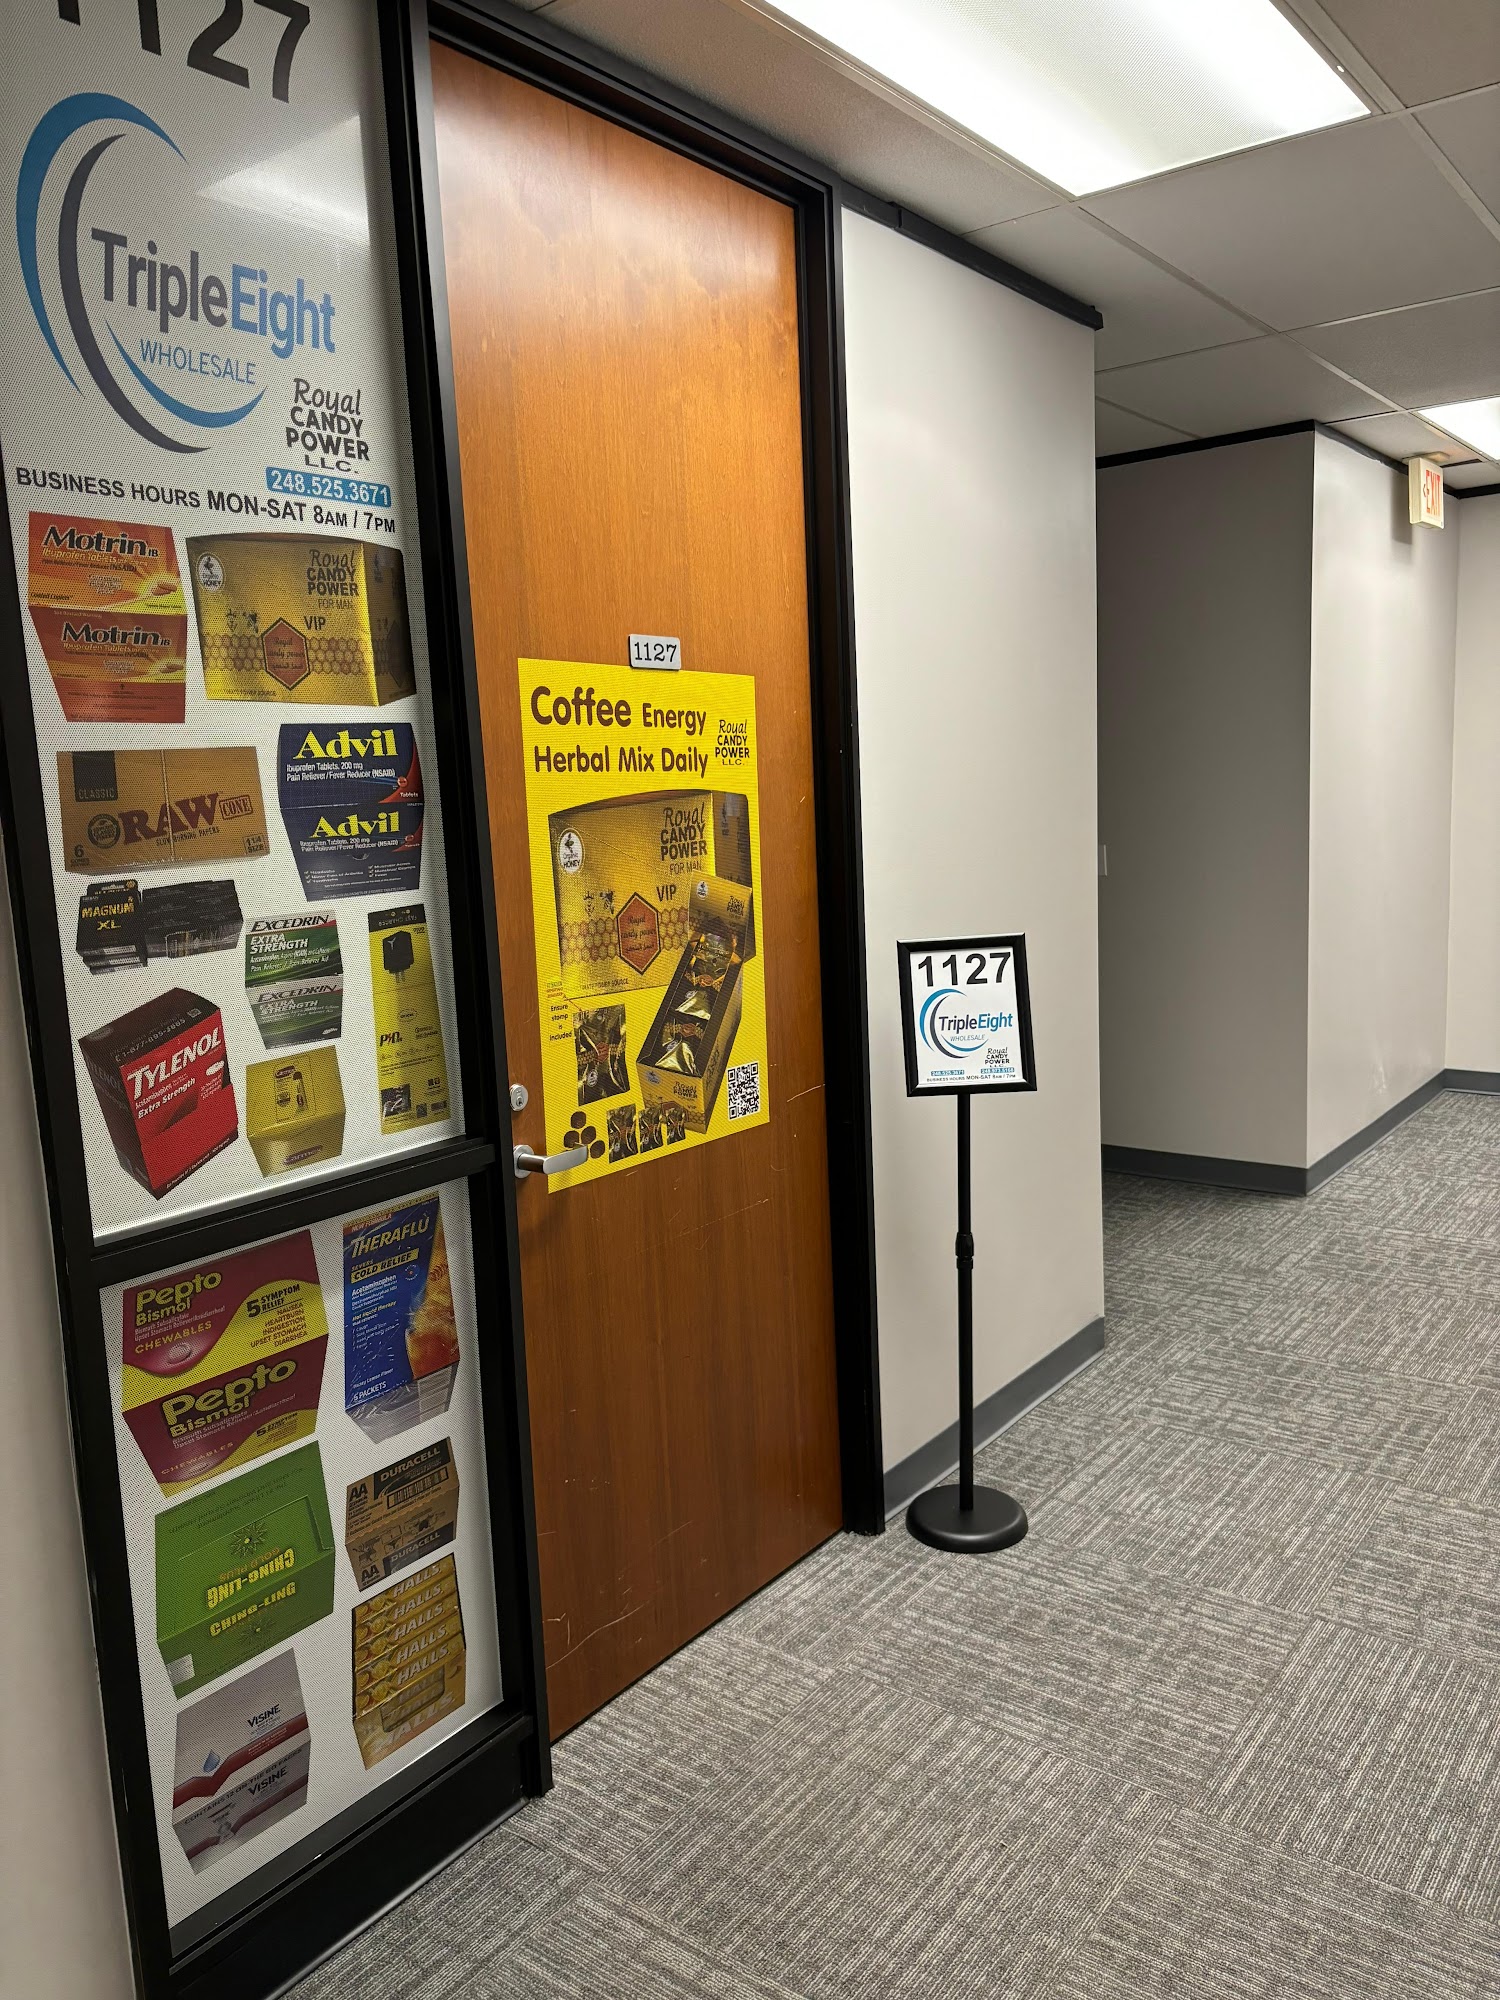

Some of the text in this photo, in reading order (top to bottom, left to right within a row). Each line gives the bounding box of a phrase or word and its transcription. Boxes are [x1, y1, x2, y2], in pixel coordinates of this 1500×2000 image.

[57, 0, 310, 104] 27
[91, 227, 336, 360] TripleEight
[140, 338, 257, 385] WHOLESALE
[293, 377, 361, 417] Royal
[290, 406, 363, 438] CANDY
[285, 426, 370, 461] POWER
[304, 454, 360, 475] LLC.
[270, 470, 389, 507] 248.525.3671
[1425, 469, 1441, 517] EXIT
[15, 467, 126, 498] BUSINESS
[131, 482, 201, 509] HOURS
[207, 489, 308, 523] MON-SAT
[363, 512, 396, 534] 7PM
[42, 525, 149, 556] Motrin
[308, 549, 356, 572] Royal
[306, 566, 357, 583] CANDY
[306, 581, 360, 598] POWER
[318, 598, 335, 610] FOR
[62, 621, 161, 647] Motrin
[303, 615, 327, 632] VIP
[633, 642, 678, 663] 1127
[530, 685, 707, 737] Coffee Energy
[716, 734, 749, 747] CANDY
[718, 718, 748, 740] Royal
[293, 728, 399, 760] Advil
[714, 746, 750, 760] POWER
[286, 763, 316, 774] Ibuprofen
[341, 761, 353, 770] 200
[533, 744, 709, 779] Herbal Mix Daily
[286, 768, 396, 782] Pain Reducer (NSAID)
[78, 787, 116, 801] CLASSIC
[118, 792, 220, 846] RAW
[222, 797, 251, 818] CONE
[308, 810, 401, 840] Advil
[662, 801, 706, 829] Royal
[660, 823, 707, 845] CANDY
[74, 844, 85, 858] 6
[659, 838, 708, 862] POWER
[562, 859, 582, 869] HONEY
[669, 859, 703, 875] FOR MAN
[656, 884, 678, 902] VIP
[81, 902, 136, 919] MAGNUM
[97, 920, 122, 931] XL
[251, 914, 330, 933] EXCEDRIN
[249, 938, 310, 955] STRENGTH
[250, 933, 286, 946] EXTRA
[917, 951, 1011, 988] 1127
[550, 1003, 569, 1012] Ensure
[938, 1011, 1013, 1034] TripleEight
[549, 1030, 573, 1041] included
[950, 1033, 986, 1043] WHOLESALE
[987, 1046, 1008, 1056] Royal
[127, 1027, 222, 1101] TYLENOL
[137, 1100, 161, 1120] Extra
[161, 1077, 196, 1104] Strength
[354, 1252, 412, 1281] COLD RELIEF
[135, 1271, 223, 1314] Pepto
[260, 1283, 301, 1305] SYMPTOM
[351, 1274, 397, 1298] Acetaminophen
[135, 1298, 193, 1328] Bismol
[246, 1298, 261, 1319] 5
[261, 1298, 286, 1312] RELIEF
[262, 1315, 307, 1337] INDIGESTION
[264, 1308, 305, 1328] HEARTBURN
[135, 1320, 213, 1355] CHEWABLES
[150, 1325, 173, 1339] Stomach
[250, 1322, 308, 1349] UPSET STOMACH
[162, 1358, 298, 1427] Pepto
[358, 1381, 388, 1400] PACKETS
[169, 1396, 250, 1439] Bismol
[380, 1446, 442, 1483] DURACELL
[350, 1482, 369, 1501] AA
[390, 1531, 442, 1564] DURACELL
[206, 1547, 297, 1611] CHING-LING
[361, 1563, 380, 1584] AA
[208, 1580, 297, 1638] CHING-LING
[247, 1703, 282, 1729] VISINE
[248, 1765, 289, 1797] VISINE
